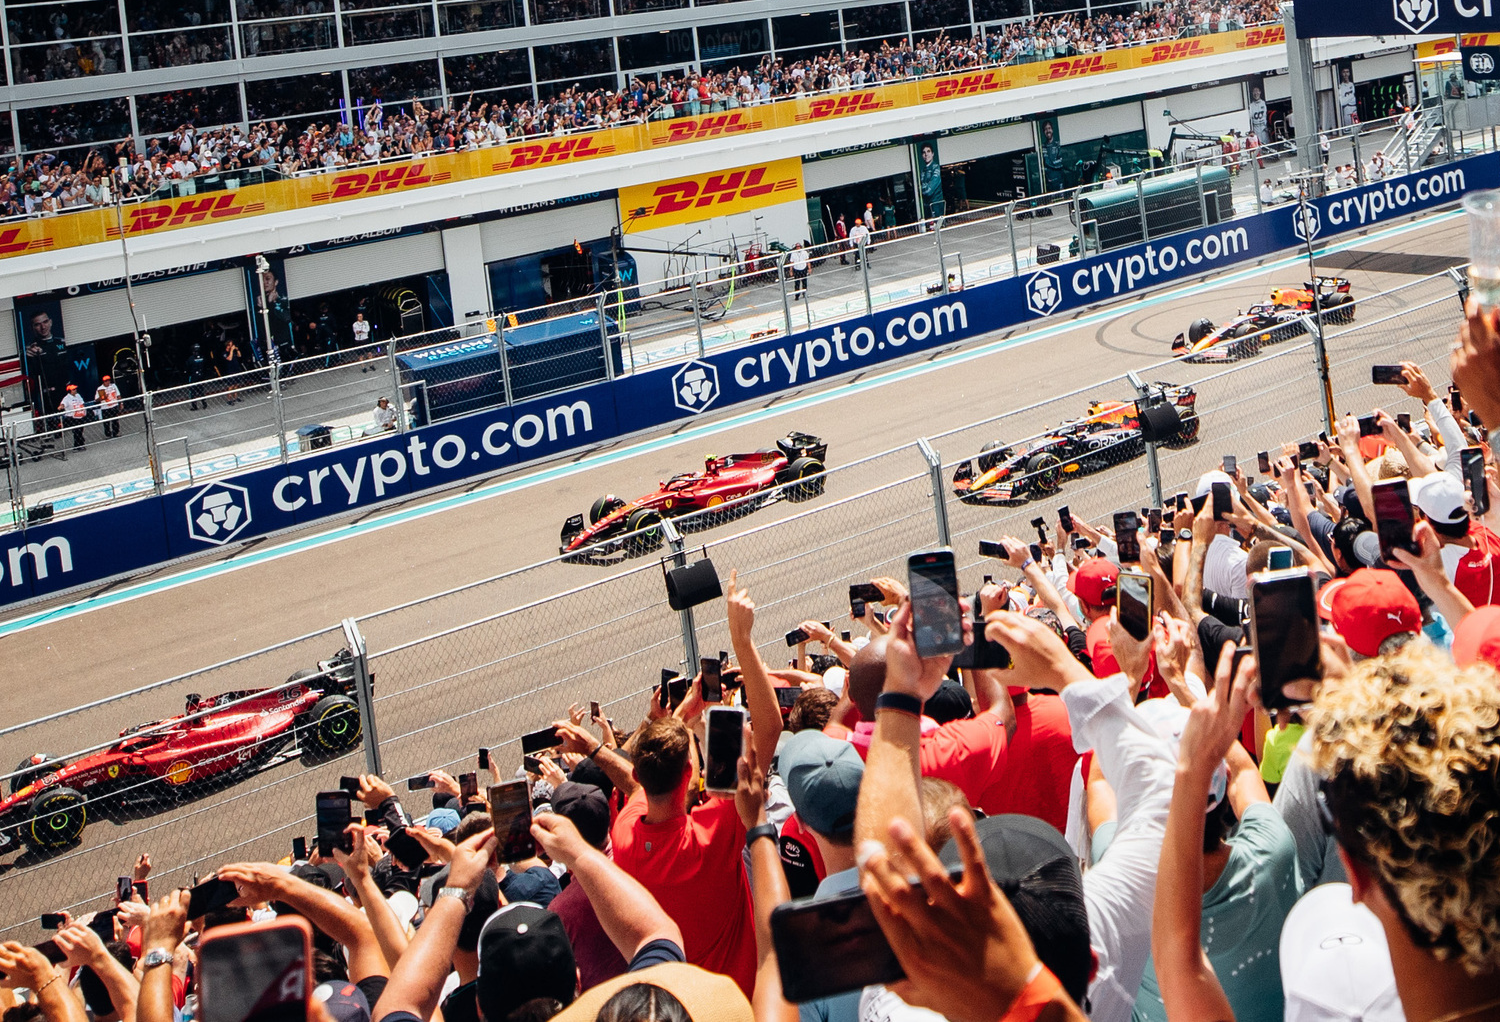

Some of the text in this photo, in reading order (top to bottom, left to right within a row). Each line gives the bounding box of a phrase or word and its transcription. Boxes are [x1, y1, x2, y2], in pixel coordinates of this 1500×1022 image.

[1150, 40, 1204, 63] DHL
[1049, 56, 1107, 80] DHL
[1471, 56, 1492, 72] FIA
[935, 72, 1001, 99] DHL
[809, 92, 881, 120] DHL
[665, 113, 749, 143] DHL
[509, 135, 600, 169] DHL
[332, 164, 433, 199] DHL
[654, 167, 775, 216] DHL
[1016, 186, 1026, 198] 5
[500, 198, 556, 215] WILLIAMS
[1328, 169, 1466, 226] crypto.com
[129, 194, 245, 232] DHL
[1072, 226, 1249, 296] crypto.com
[414, 338, 493, 360] WILLIAMS
[427, 344, 489, 362] RACING
[734, 301, 967, 388] crypto.com
[1089, 430, 1143, 450] ORACLE
[272, 400, 594, 512] crypto.com
[761, 453, 775, 464] 55
[269, 697, 307, 716] Santander
[278, 686, 302, 703] 16
[785, 841, 801, 854] aws
